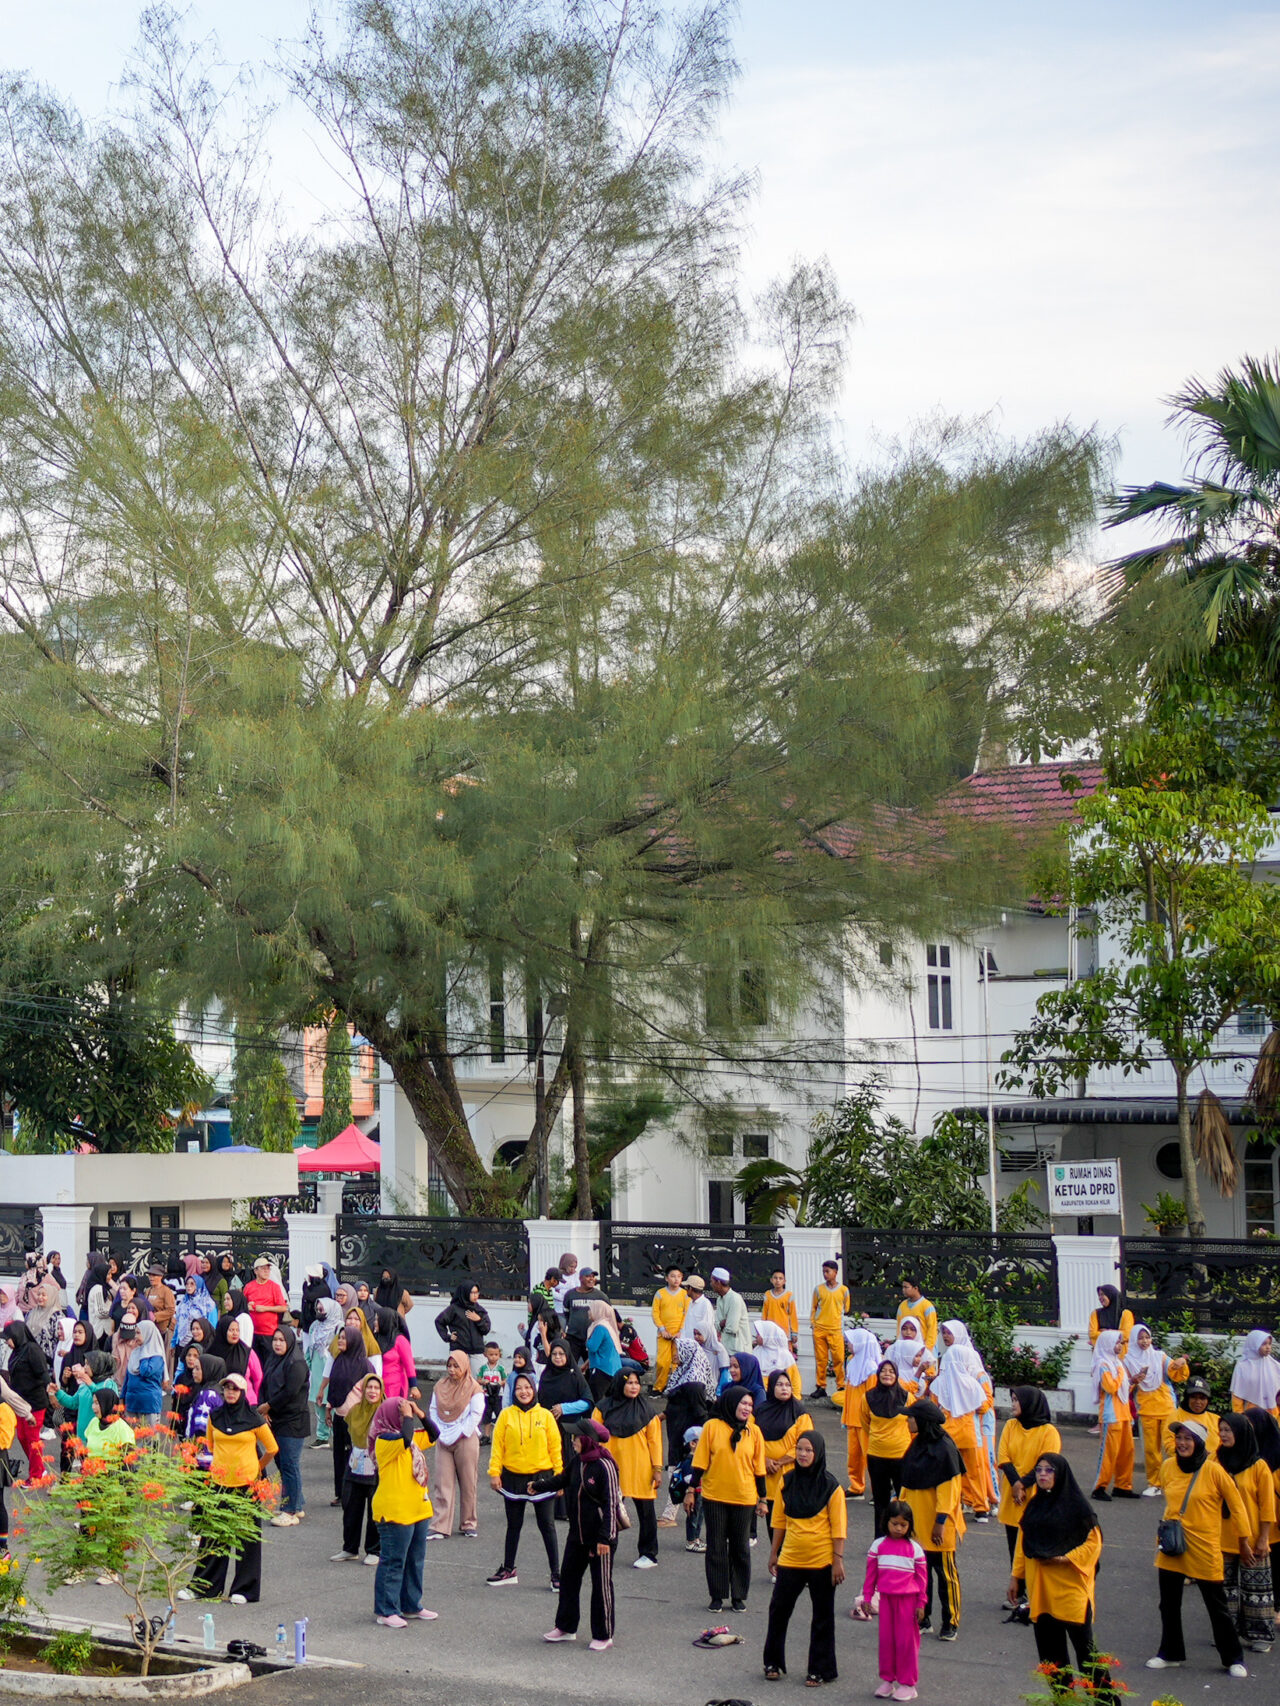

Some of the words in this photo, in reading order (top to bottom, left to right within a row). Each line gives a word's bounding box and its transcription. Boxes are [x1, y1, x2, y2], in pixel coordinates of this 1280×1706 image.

[1070, 1167, 1091, 1179] RUMAH
[1093, 1166, 1112, 1178] DINAS
[1055, 1184, 1087, 1196] KETUA
[1090, 1183, 1115, 1195] DPRD
